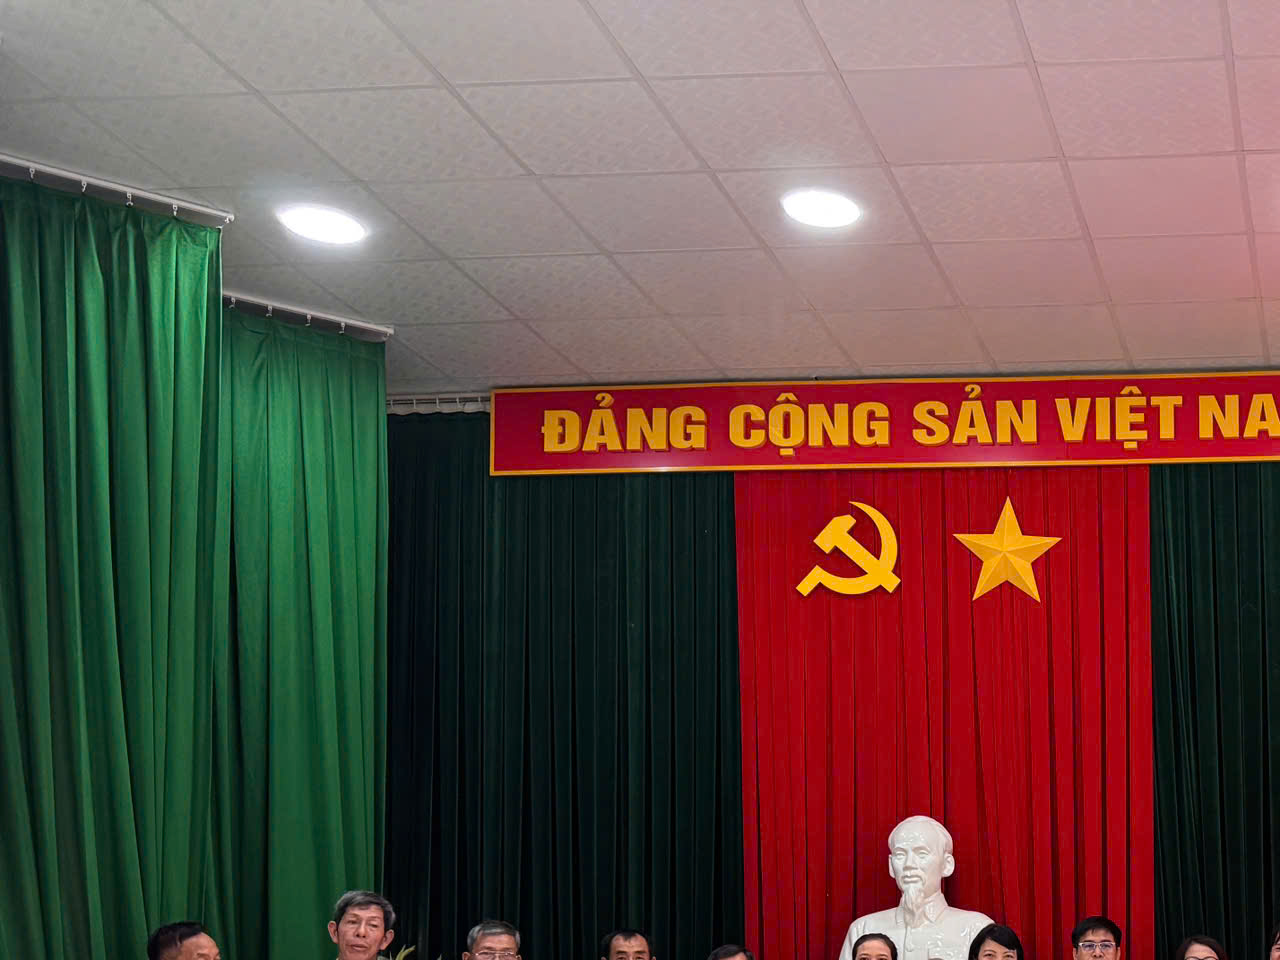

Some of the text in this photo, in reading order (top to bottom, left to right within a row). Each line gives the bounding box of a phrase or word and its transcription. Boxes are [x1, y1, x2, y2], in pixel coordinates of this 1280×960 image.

[542, 394, 705, 451] ĐẢNG
[730, 393, 888, 455] CỘNG
[913, 385, 1037, 444] SẢN
[1056, 386, 1182, 448] VIỆT
